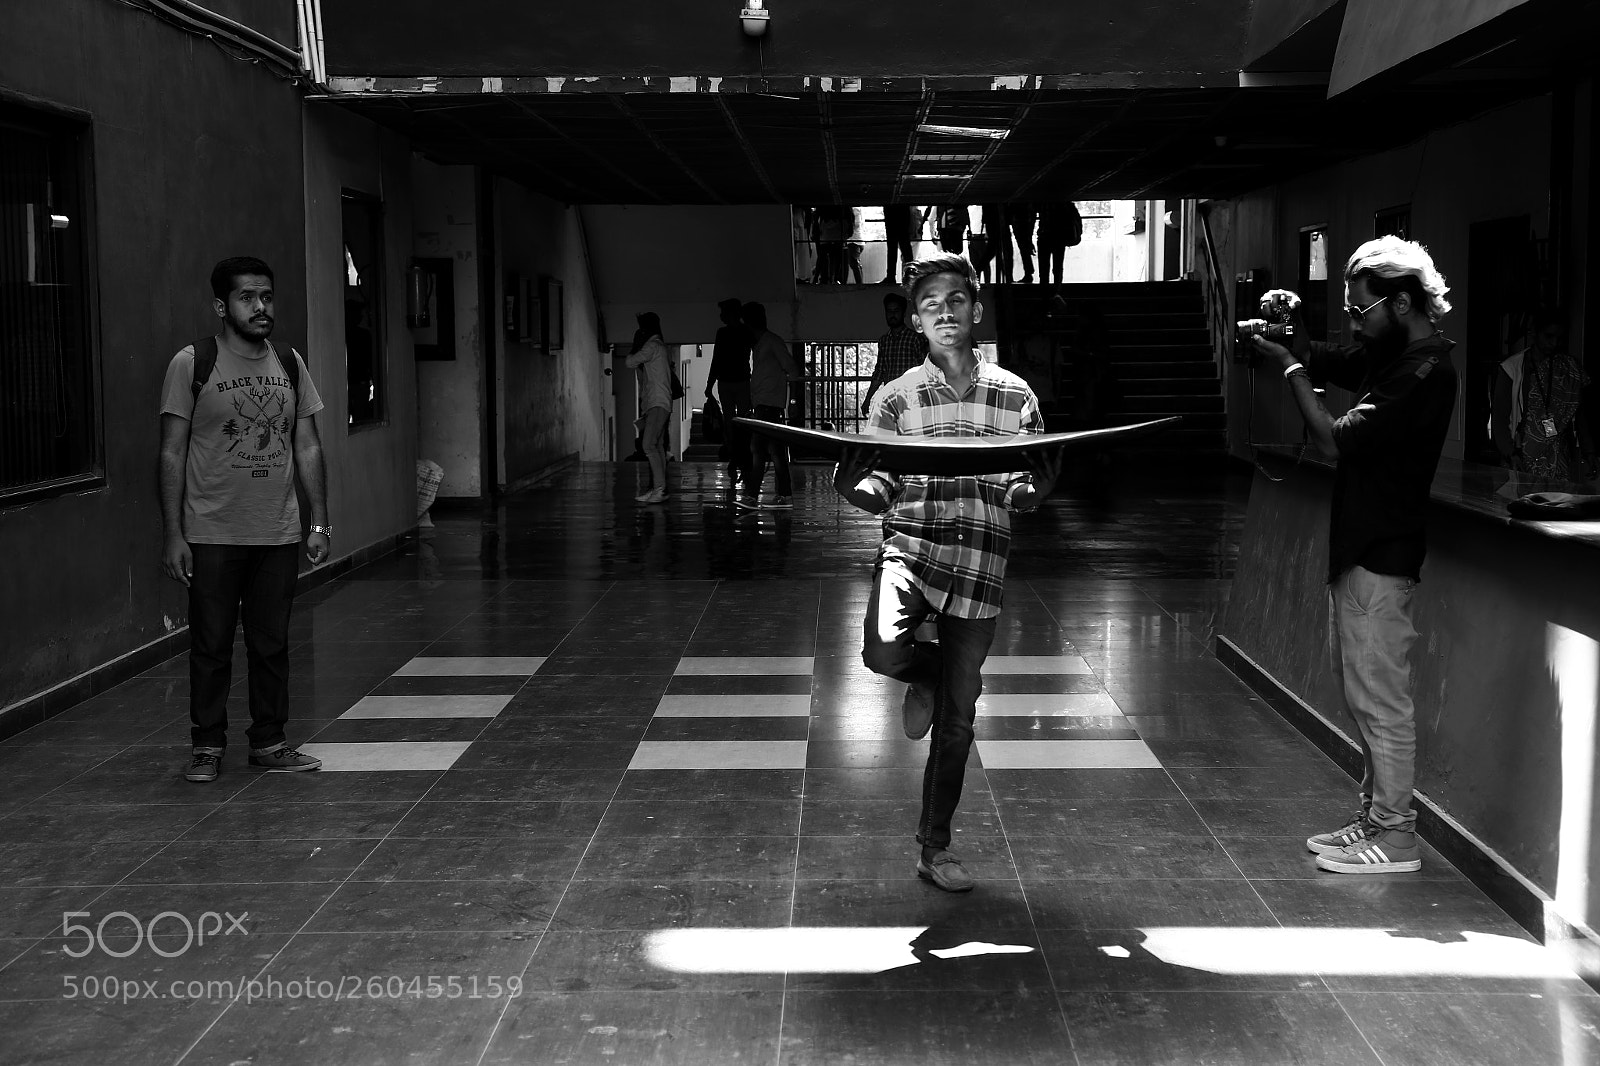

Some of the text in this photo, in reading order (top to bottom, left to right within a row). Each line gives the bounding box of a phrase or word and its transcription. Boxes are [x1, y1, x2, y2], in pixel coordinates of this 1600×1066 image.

[217, 377, 252, 393] BLACK
[237, 449, 282, 462] CLASSIC POLO
